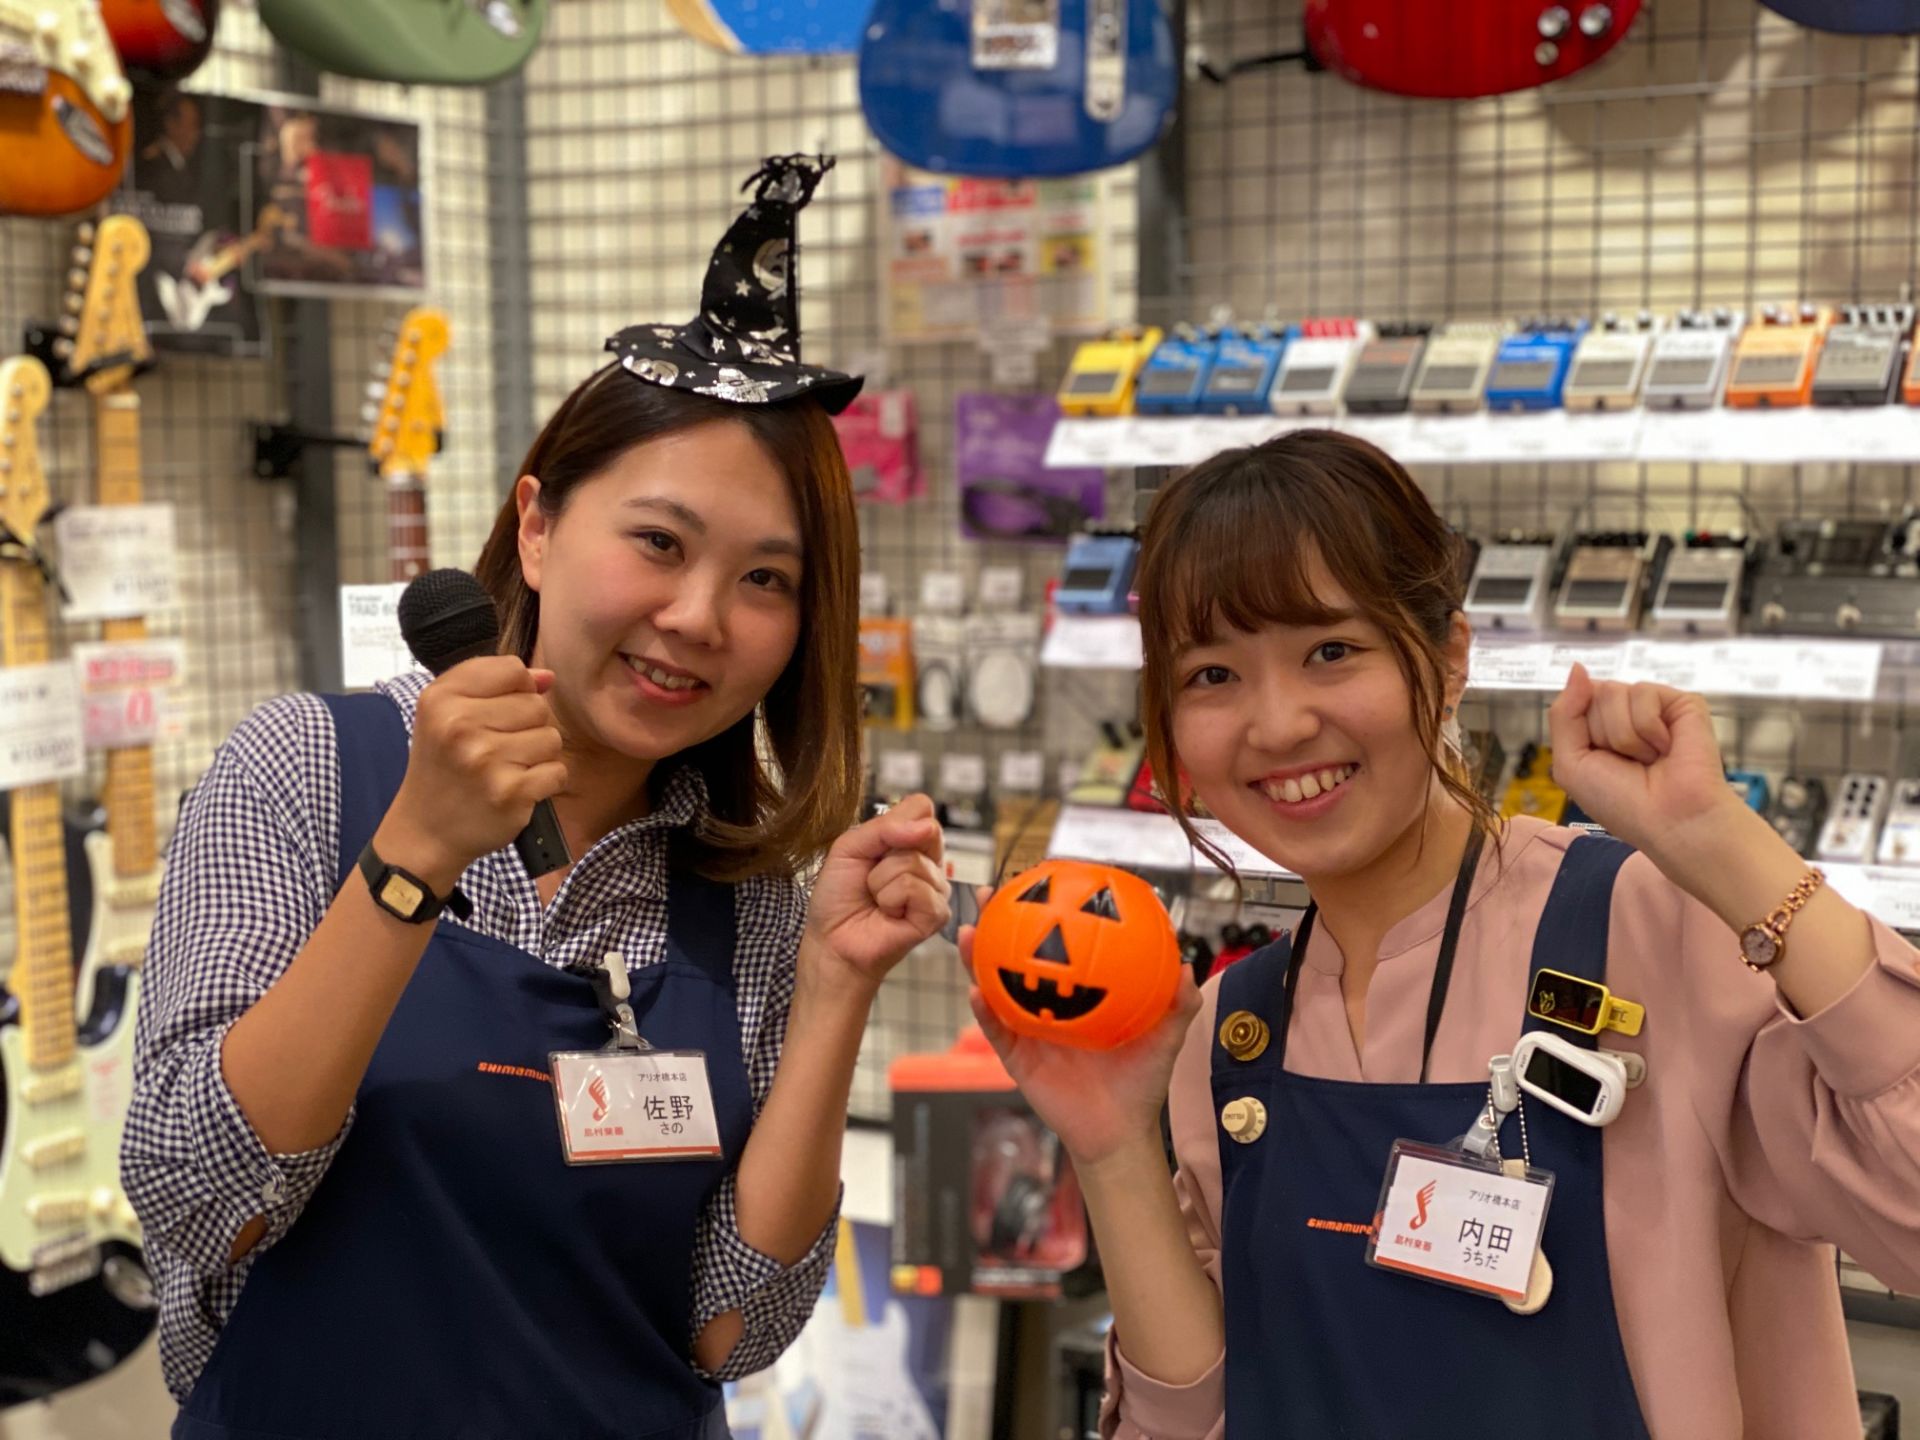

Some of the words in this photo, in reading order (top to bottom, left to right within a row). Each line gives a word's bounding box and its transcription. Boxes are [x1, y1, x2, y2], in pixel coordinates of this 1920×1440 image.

[638, 1073, 688, 1082] アリオ橋本店
[643, 1095, 693, 1120] 佐野
[659, 1122, 684, 1136] さの
[1469, 1190, 1522, 1210] アリオ橋本店
[1458, 1217, 1513, 1253] 内田
[1462, 1248, 1500, 1270] うちだ
